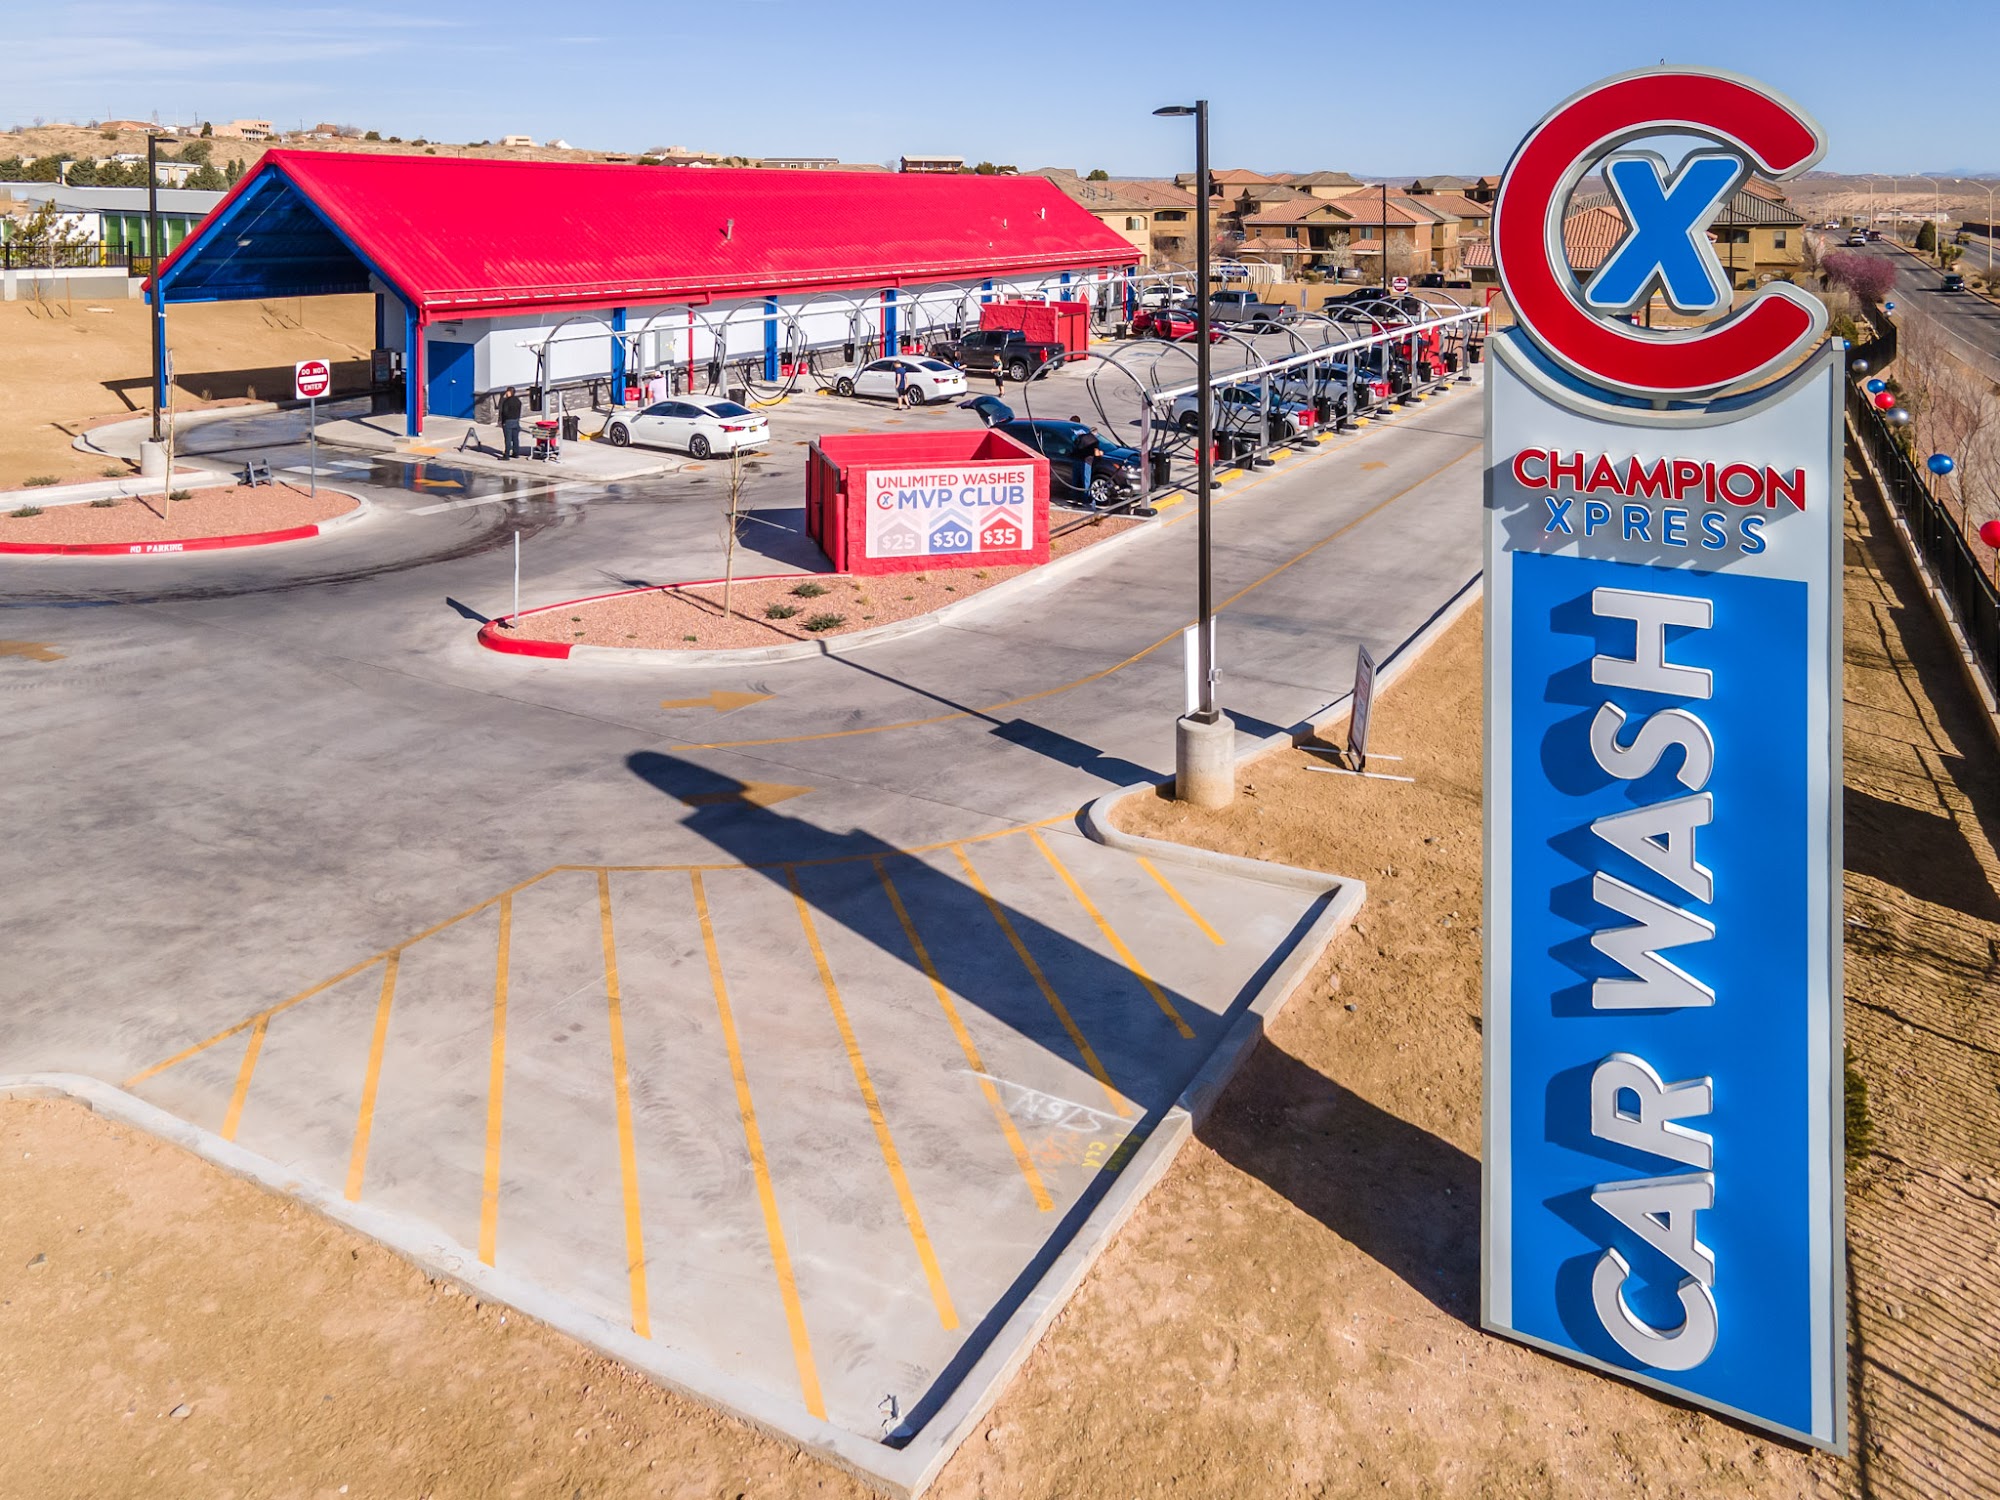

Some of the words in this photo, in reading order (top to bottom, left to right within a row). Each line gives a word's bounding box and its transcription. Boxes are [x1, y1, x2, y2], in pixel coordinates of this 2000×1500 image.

[303, 383, 322, 391] ENTER
[876, 474, 958, 488] UNLIMITED
[963, 471, 1025, 485] WASHES
[1512, 446, 1807, 512] CHAMPION
[898, 489, 953, 510] MVP
[959, 486, 1025, 507] CLUB
[1544, 496, 1768, 555] XPRESS
[130, 545, 142, 553] NO
[146, 544, 183, 553] PARKING
[882, 533, 916, 550] $25
[933, 530, 969, 547] $30
[983, 528, 1016, 545] $35
[1590, 587, 1715, 1010] WASH
[1590, 1052, 1718, 1371] CAR
